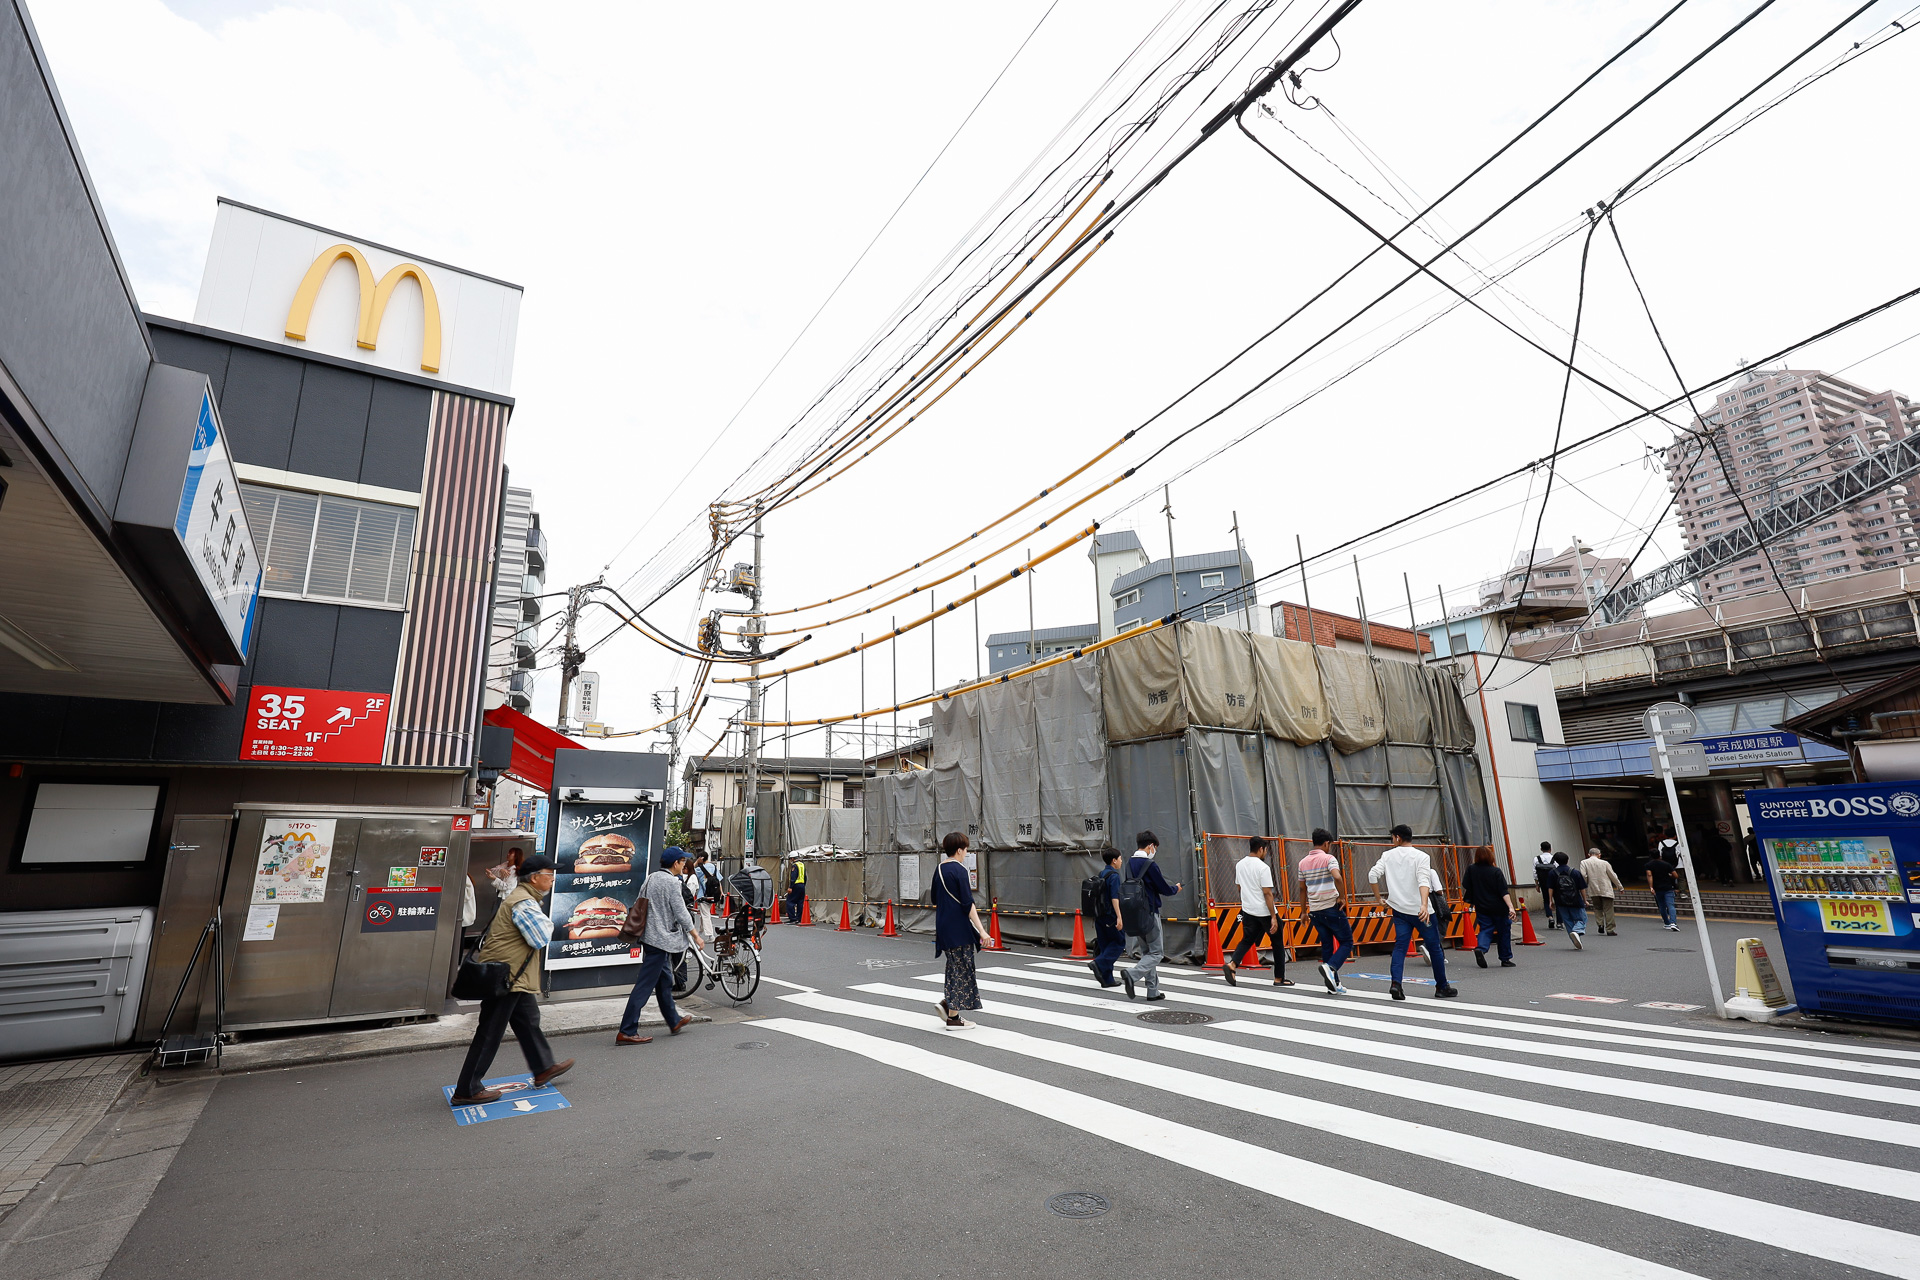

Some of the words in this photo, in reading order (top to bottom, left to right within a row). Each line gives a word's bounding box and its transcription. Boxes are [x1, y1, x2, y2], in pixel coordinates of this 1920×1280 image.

[210, 478, 246, 592] 牛田駅
[1147, 689, 1169, 707] 防音
[1225, 692, 1246, 708] 防音
[257, 694, 306, 719] 35
[365, 698, 385, 709] 2F
[1301, 705, 1318, 720] 防音
[1362, 714, 1375, 728] 防音
[257, 719, 302, 731] SEAT
[305, 731, 323, 743] 1F
[1717, 736, 1784, 752] 京成関屋駅
[1714, 754, 1737, 762] Keisei
[1738, 752, 1764, 761] Sekiya
[1765, 749, 1794, 757] Station
[1759, 800, 1806, 809] SUNTORY
[1808, 796, 1888, 818] BOSS
[569, 807, 645, 831] サムライマック
[1761, 808, 1809, 819] COFFEE
[1018, 823, 1033, 836] 防音
[1084, 818, 1104, 832] 防音
[397, 906, 435, 916] 駐輪禁止
[1829, 902, 1878, 917] 100円
[1830, 920, 1881, 931] ワンコイン
